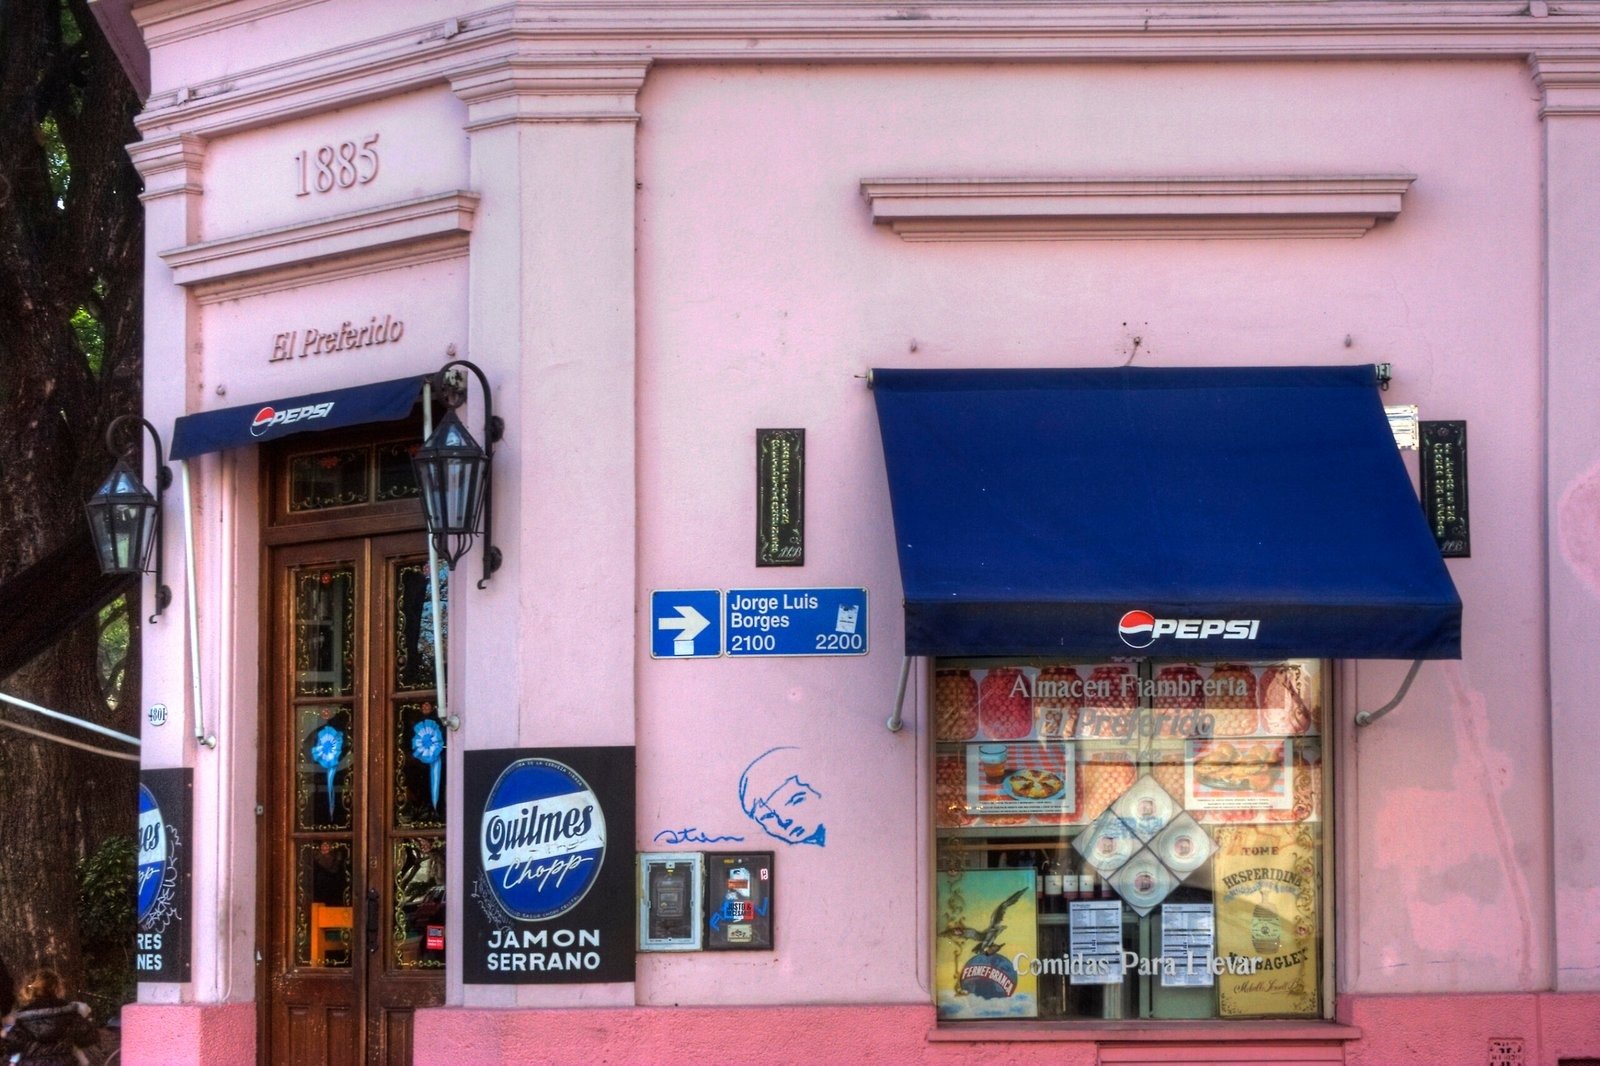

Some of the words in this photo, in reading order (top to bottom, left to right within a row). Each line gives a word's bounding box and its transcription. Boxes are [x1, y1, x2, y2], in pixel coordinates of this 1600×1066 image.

[294, 133, 380, 197] 1885
[269, 331, 297, 362] El
[299, 314, 405, 359] Preferido
[268, 401, 335, 427] PEPSI
[731, 594, 779, 614] Jorge
[783, 593, 819, 610] Luis
[731, 612, 790, 632] Borges
[1151, 618, 1261, 640] PEPSI
[731, 635, 776, 651] 2100
[815, 634, 862, 650] 2200
[486, 804, 594, 862] Quilmes
[1242, 846, 1280, 857] TOME
[503, 853, 594, 893] Chopp
[487, 929, 600, 948] JAMON
[487, 952, 600, 971] SERRANO
[1012, 951, 1110, 977] Comidas
[1121, 951, 1177, 977] Para
[1186, 951, 1264, 977] Llevar
